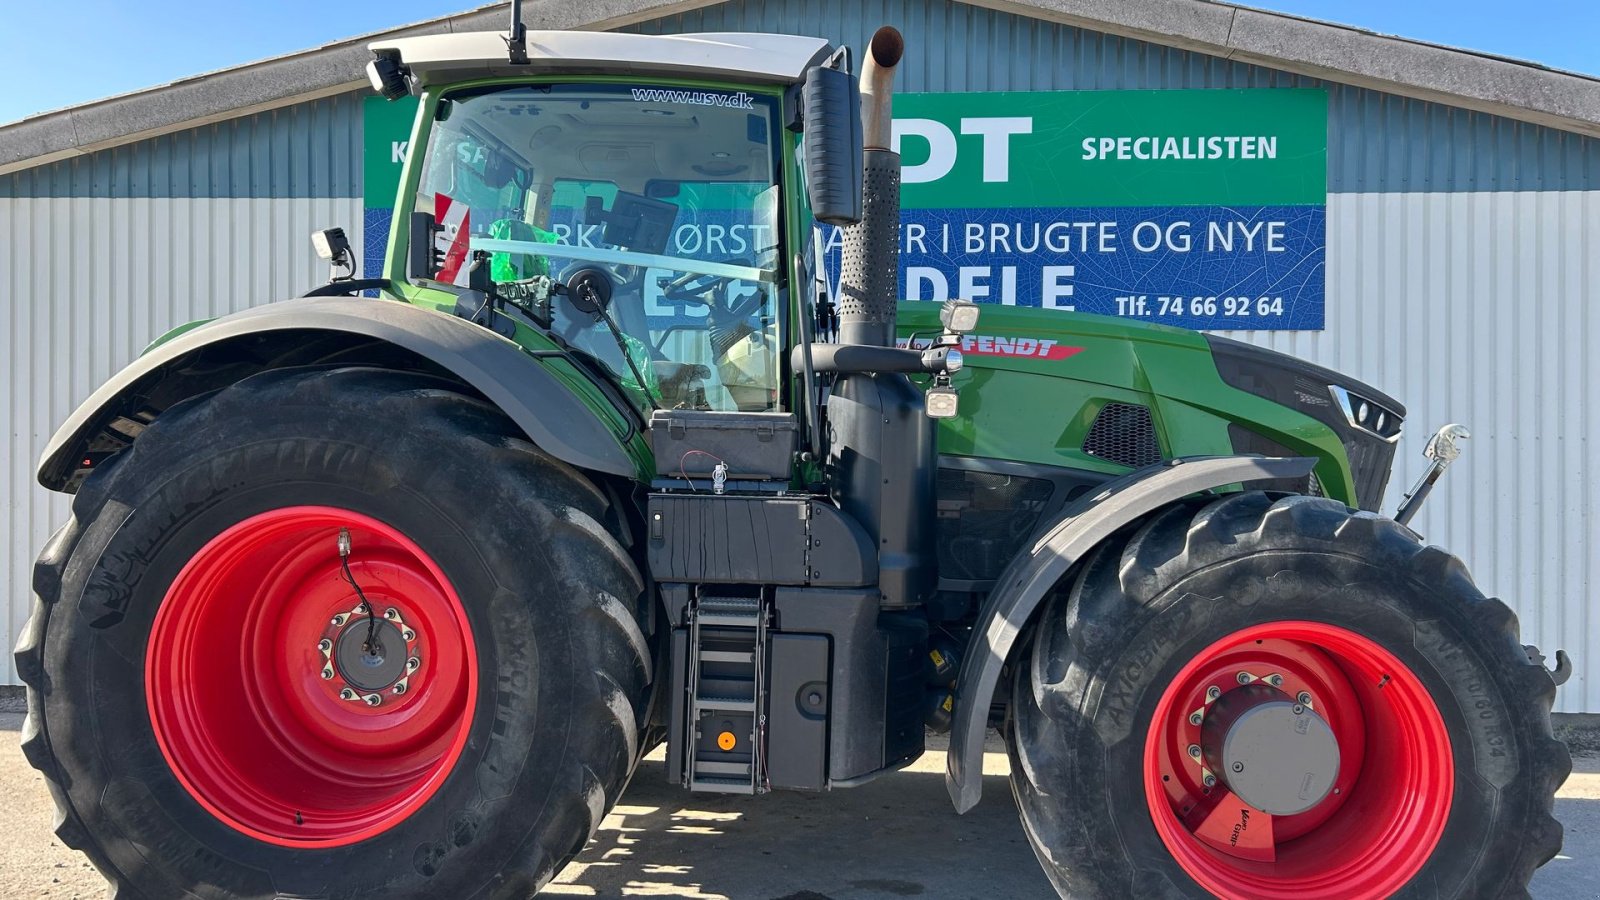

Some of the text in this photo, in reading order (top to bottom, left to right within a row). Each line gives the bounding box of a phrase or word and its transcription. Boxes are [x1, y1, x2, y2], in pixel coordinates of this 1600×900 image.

[631, 88, 754, 109] www.usv.dk
[1081, 136, 1277, 160] SPECIALISTEN
[965, 222, 1117, 253] BRUGTE
[1132, 221, 1191, 252] OG
[1208, 221, 1286, 252] NYE
[1115, 296, 1283, 316] Tlf. 74 66 92 64
[962, 334, 1058, 357] FENDT
